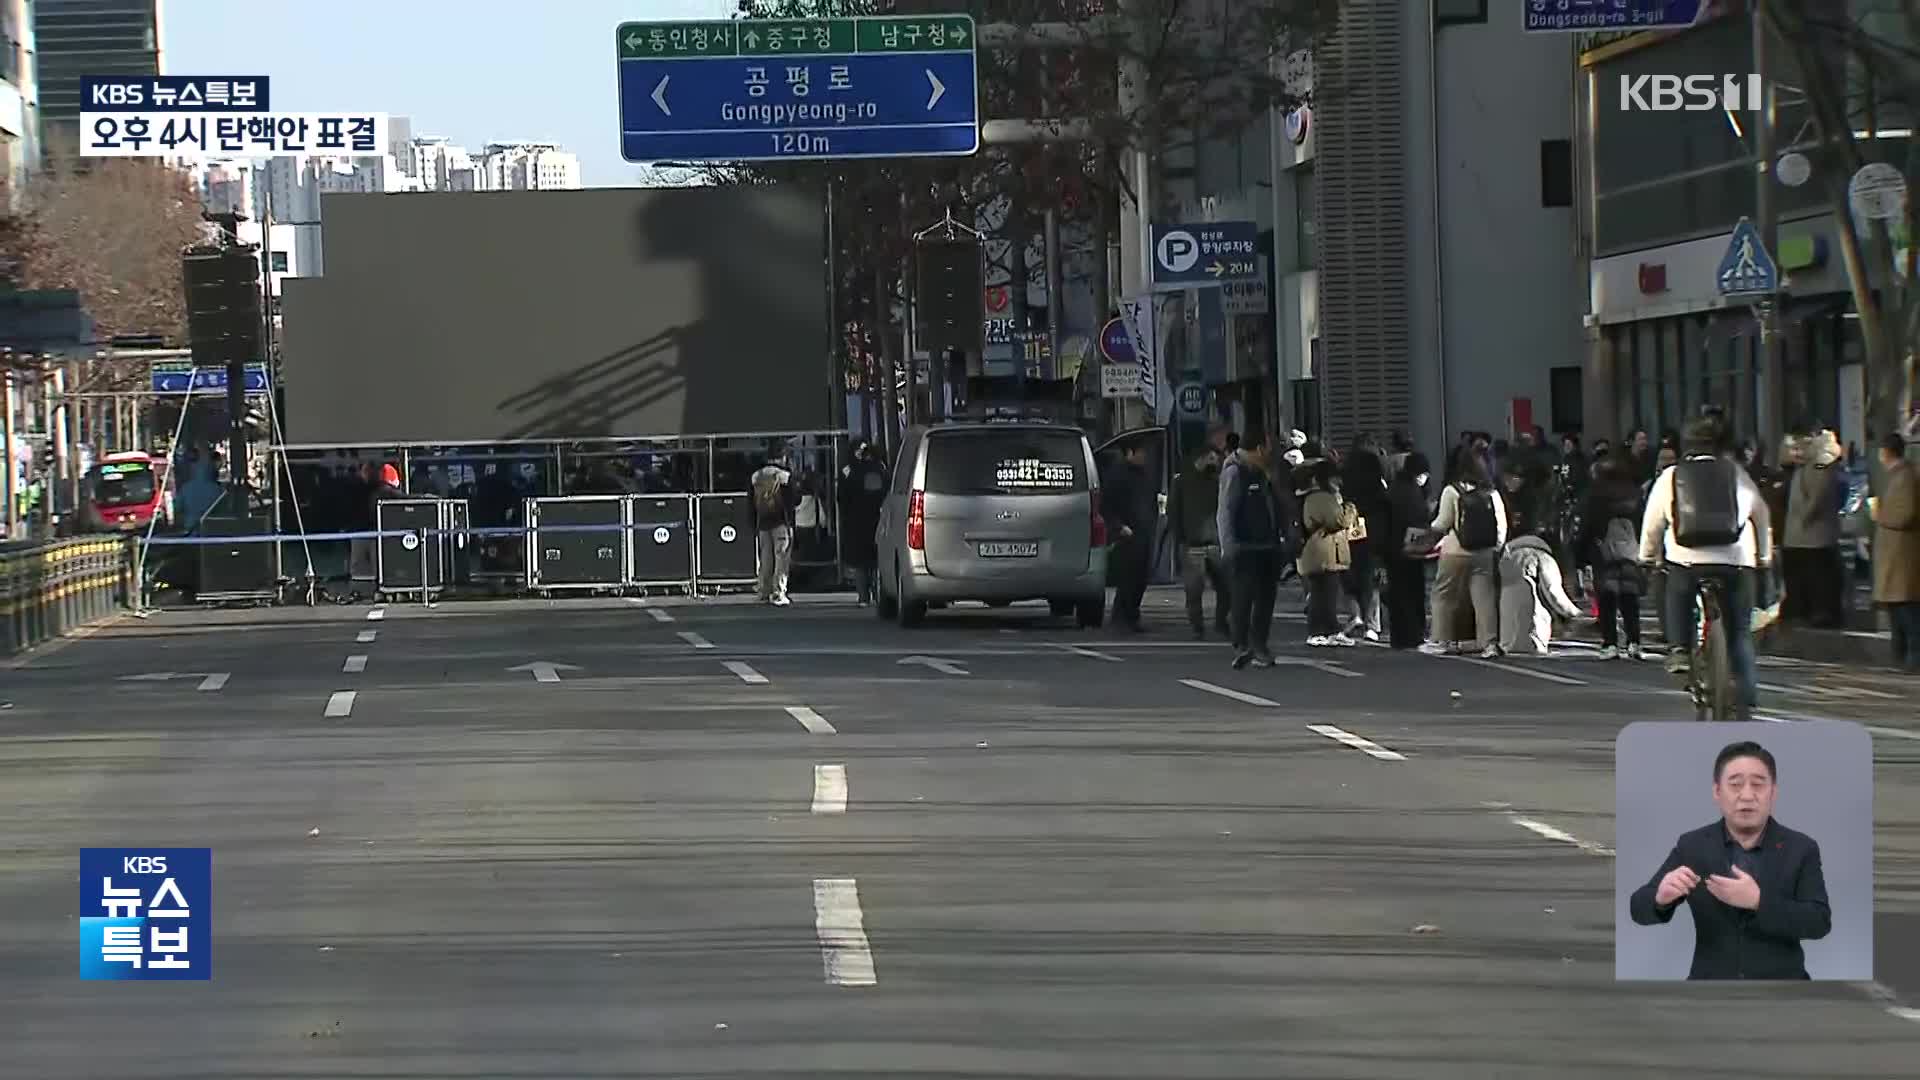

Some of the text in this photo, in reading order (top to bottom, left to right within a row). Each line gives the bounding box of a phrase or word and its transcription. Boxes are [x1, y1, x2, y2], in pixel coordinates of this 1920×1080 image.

[648, 28, 731, 51] 동인청사
[766, 25, 832, 50] 중구청
[881, 24, 945, 48] 남구청
[721, 101, 877, 125] Gongpyeong-ro
[772, 132, 830, 154] 120m
